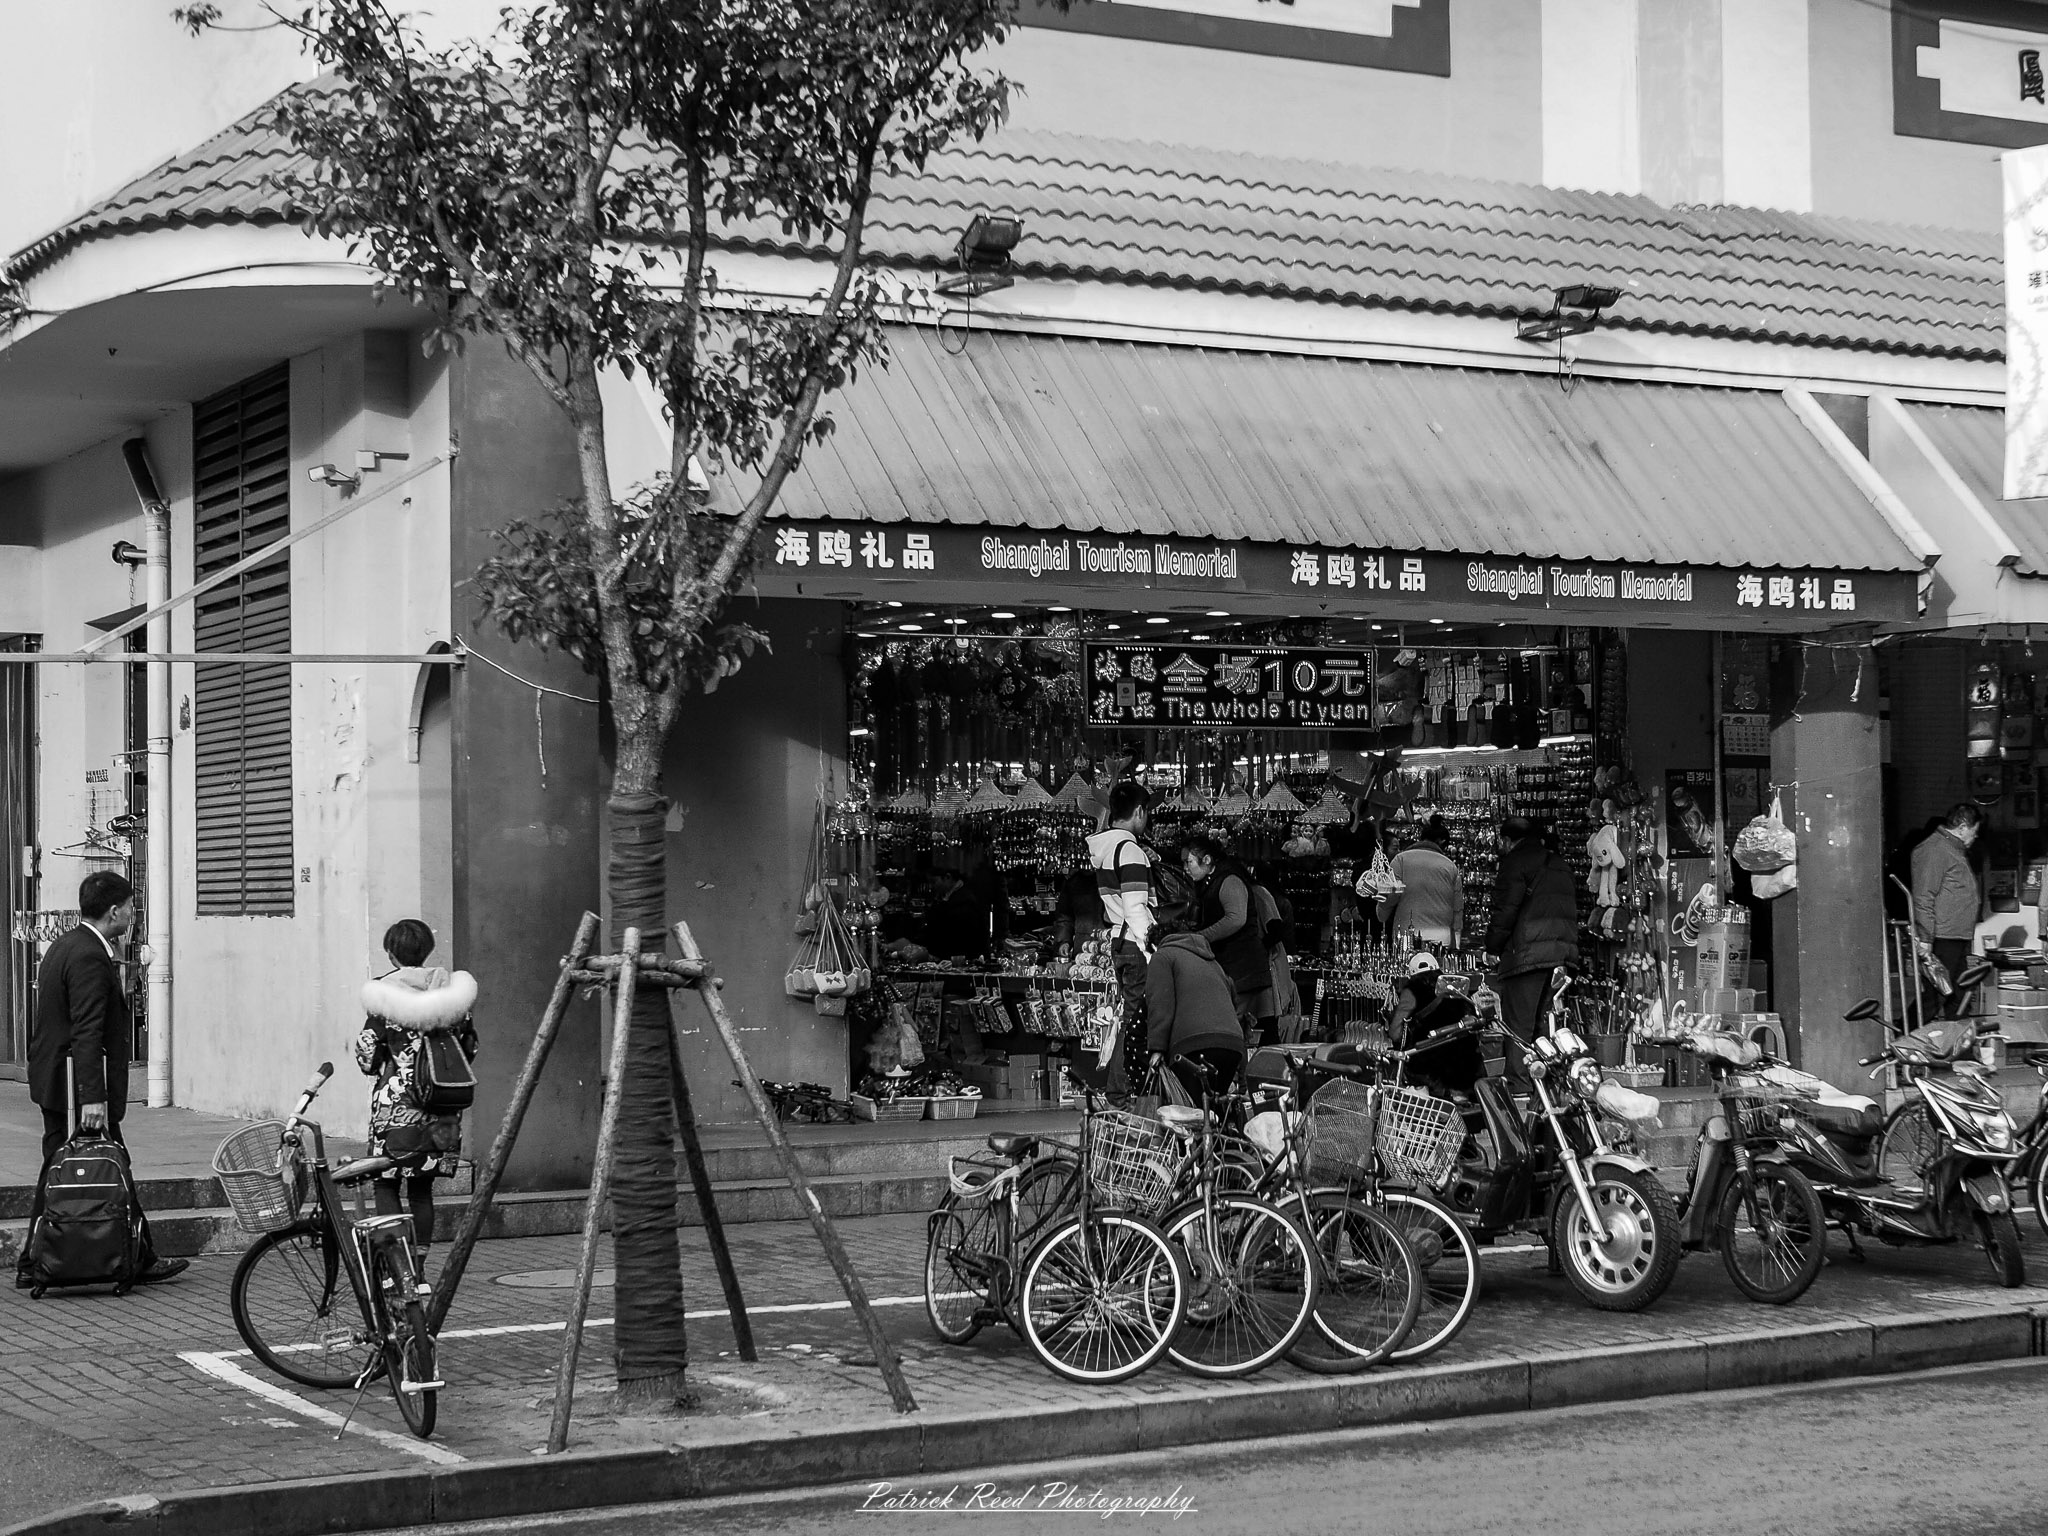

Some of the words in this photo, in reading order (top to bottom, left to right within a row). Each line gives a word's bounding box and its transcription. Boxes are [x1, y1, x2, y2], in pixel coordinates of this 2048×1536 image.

[775, 528, 935, 571] 海鸥礼品
[981, 536, 1070, 577] Shanghai
[1077, 539, 1151, 574] Tourism
[1155, 544, 1238, 579] Memorial
[1290, 551, 1427, 592] 海鸥礼品
[1467, 562, 1544, 600] Shanghai
[1551, 566, 1616, 599] Tourism
[1620, 570, 1693, 602] Memorial
[1736, 574, 1857, 611] 海鸥礼品
[1162, 697, 1205, 718] The
[1211, 698, 1280, 719] whole
[1317, 703, 1369, 722] yuan
